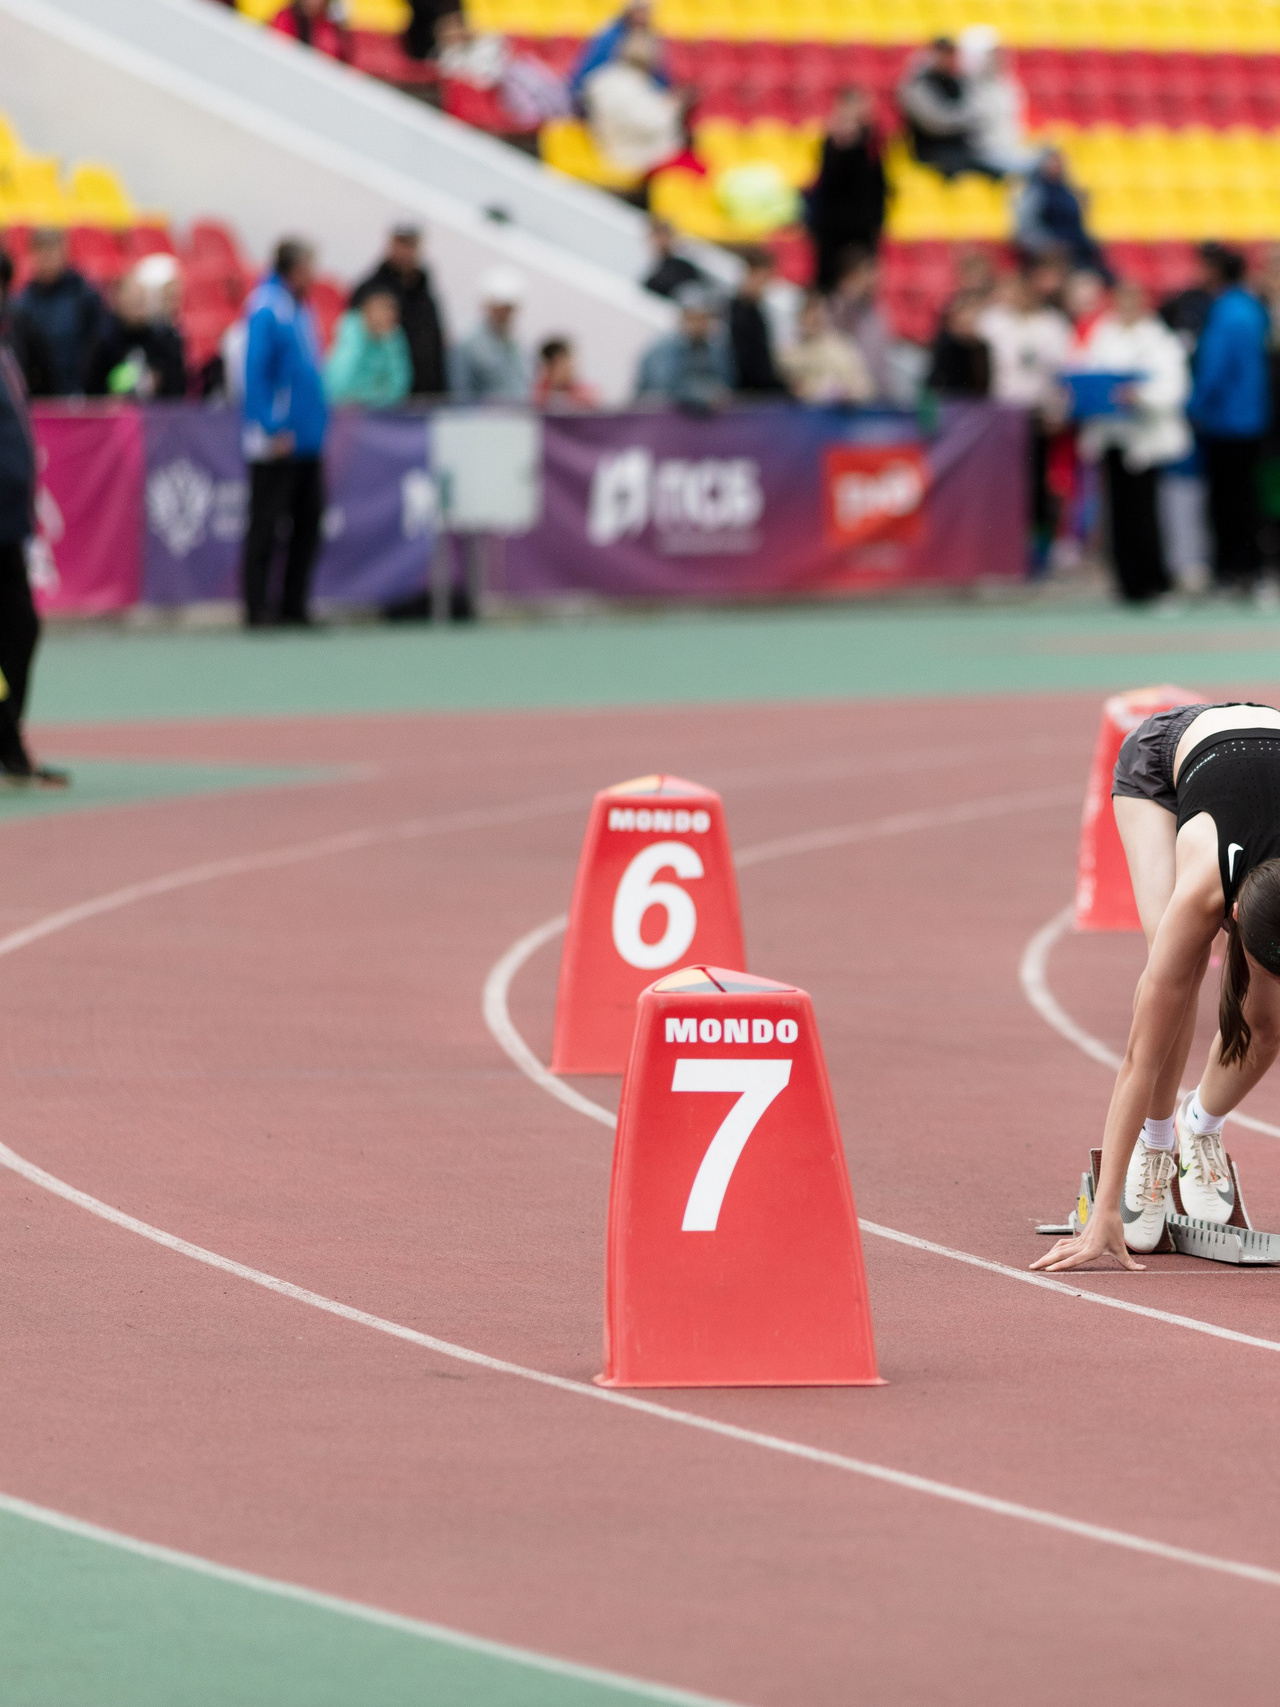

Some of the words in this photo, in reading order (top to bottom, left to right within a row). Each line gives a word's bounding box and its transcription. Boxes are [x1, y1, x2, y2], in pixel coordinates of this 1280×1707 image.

[608, 808, 711, 834] MONDO
[611, 841, 704, 969] 6
[665, 1018, 799, 1044] MONDO
[671, 1059, 793, 1231] 7
